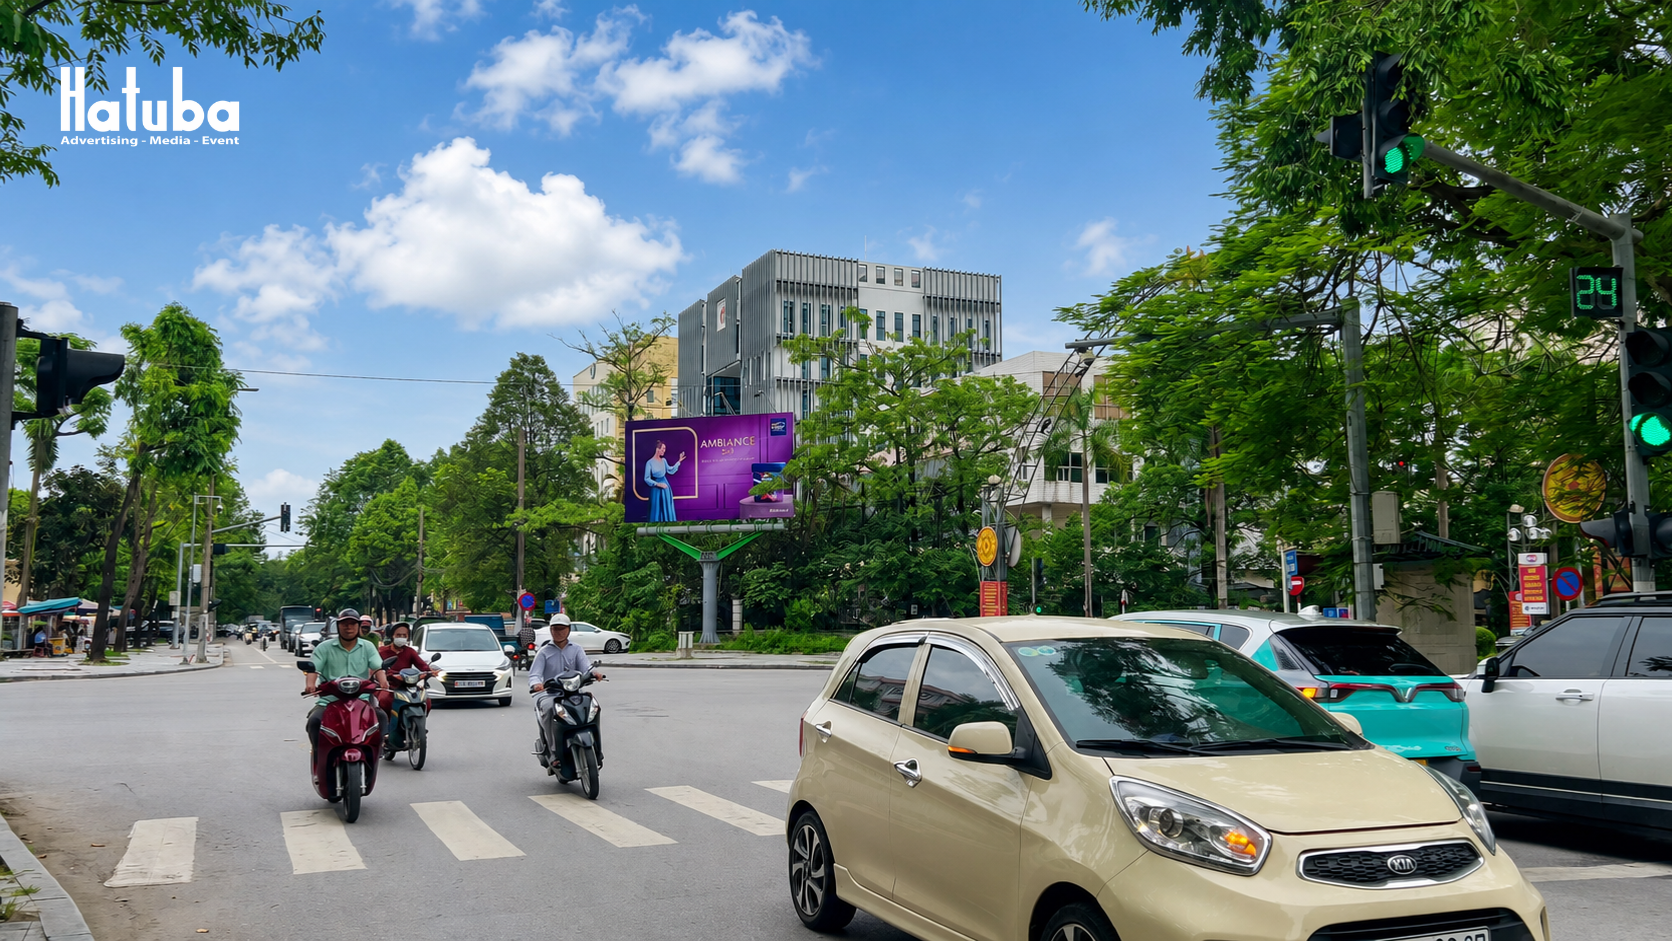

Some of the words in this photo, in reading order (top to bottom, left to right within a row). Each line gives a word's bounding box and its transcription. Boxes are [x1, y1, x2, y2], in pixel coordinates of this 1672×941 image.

[1577, 275, 1617, 309] 24
[700, 436, 756, 449] AMBIANCE
[1392, 858, 1415, 871] KIA
